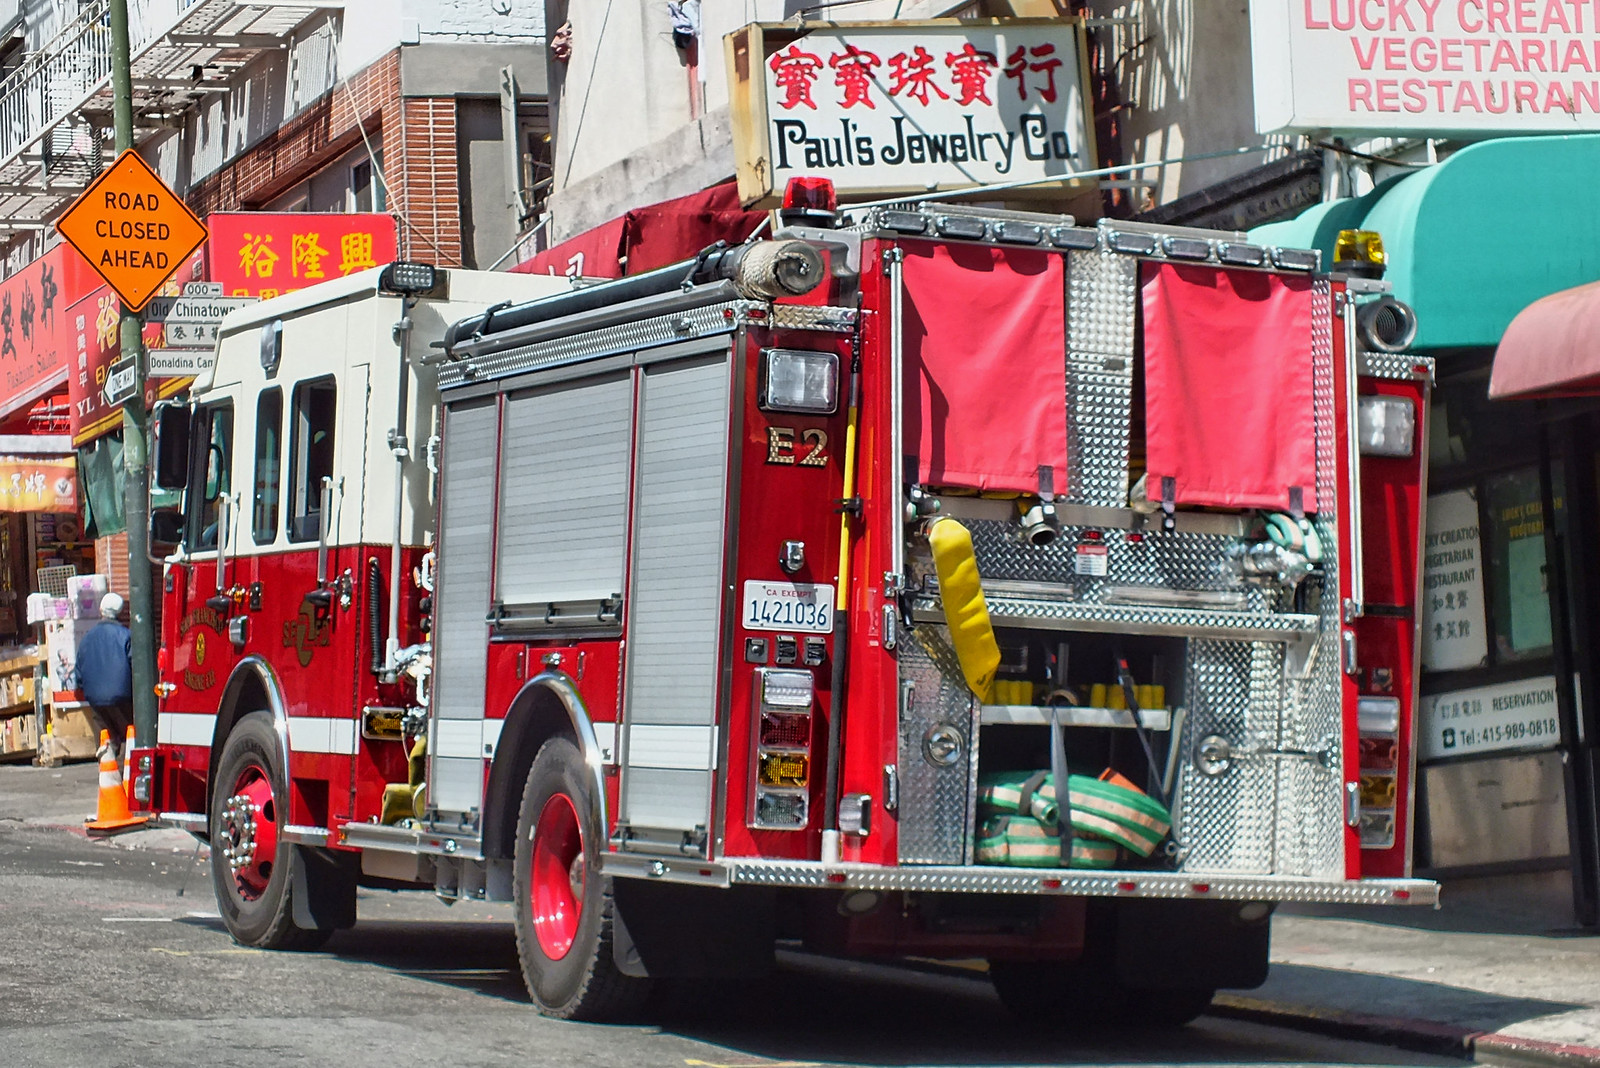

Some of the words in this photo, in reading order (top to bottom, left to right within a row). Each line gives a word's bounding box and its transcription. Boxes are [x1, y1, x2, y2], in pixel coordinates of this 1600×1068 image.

[1304, 0, 1441, 32] LUCKY
[1348, 78, 1600, 114] RESTAURAN
[773, 118, 875, 169] Paul's
[881, 114, 1014, 174] Jewelry
[1019, 113, 1079, 161] Co.
[105, 192, 159, 211] ROAD
[96, 220, 170, 240] CLOSED
[100, 249, 168, 269] AHEAD
[239, 232, 377, 278] 裕隆興
[152, 302, 169, 317] Old
[151, 357, 194, 369] Donaldina
[766, 425, 829, 467] E2
[781, 590, 812, 598] EXEMPT
[749, 600, 828, 625] 1421036
[1492, 690, 1554, 712] RESERVATION
